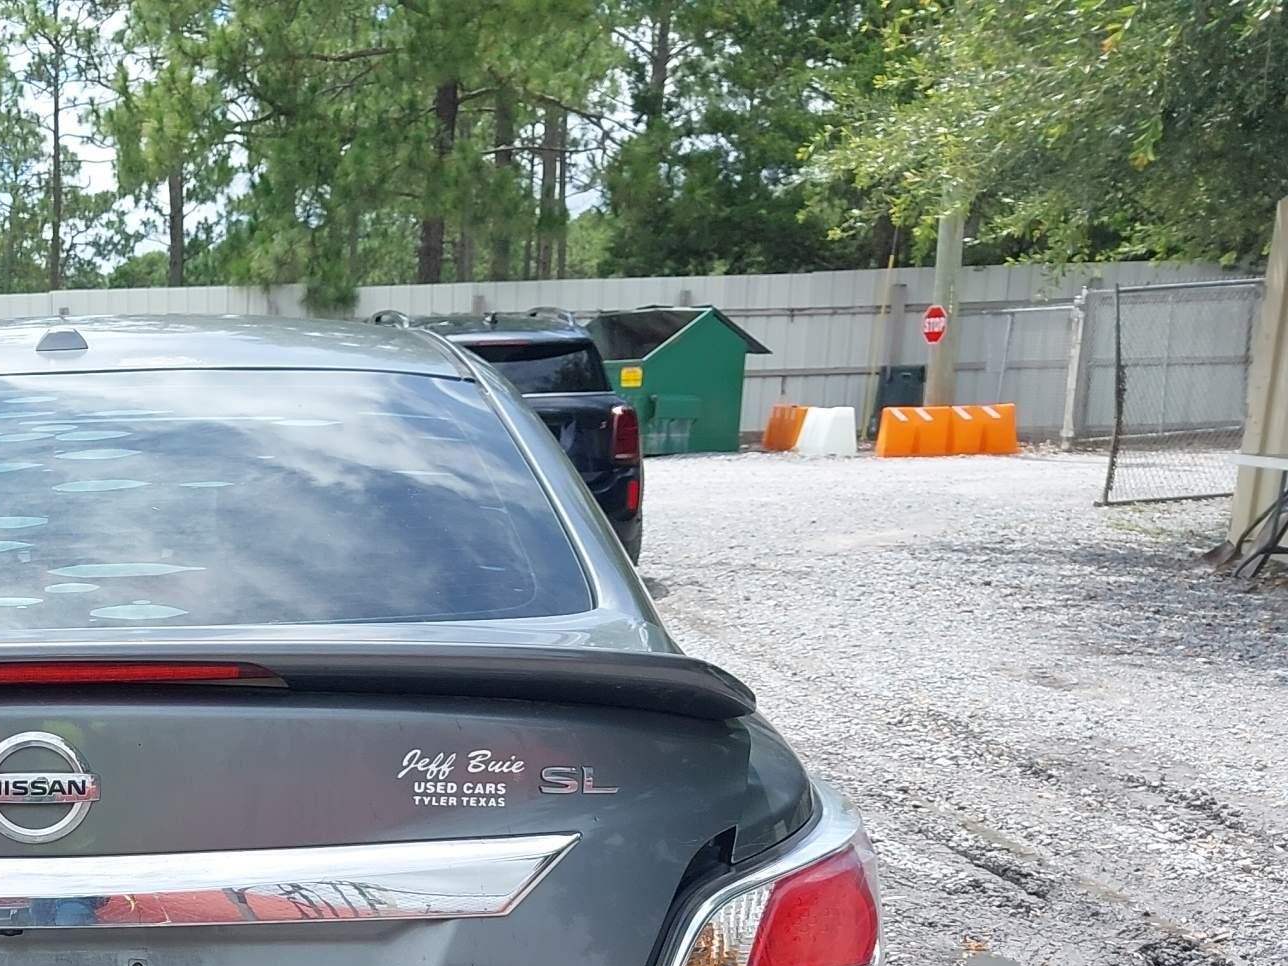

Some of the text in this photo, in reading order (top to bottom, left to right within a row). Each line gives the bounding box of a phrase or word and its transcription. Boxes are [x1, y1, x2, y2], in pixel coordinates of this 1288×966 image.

[923, 317, 946, 333] STOP
[396, 749, 526, 780] Jeff Buie
[413, 781, 507, 795] USED CARS
[539, 766, 620, 794] SL
[413, 796, 506, 808] TYLER TEXAS
